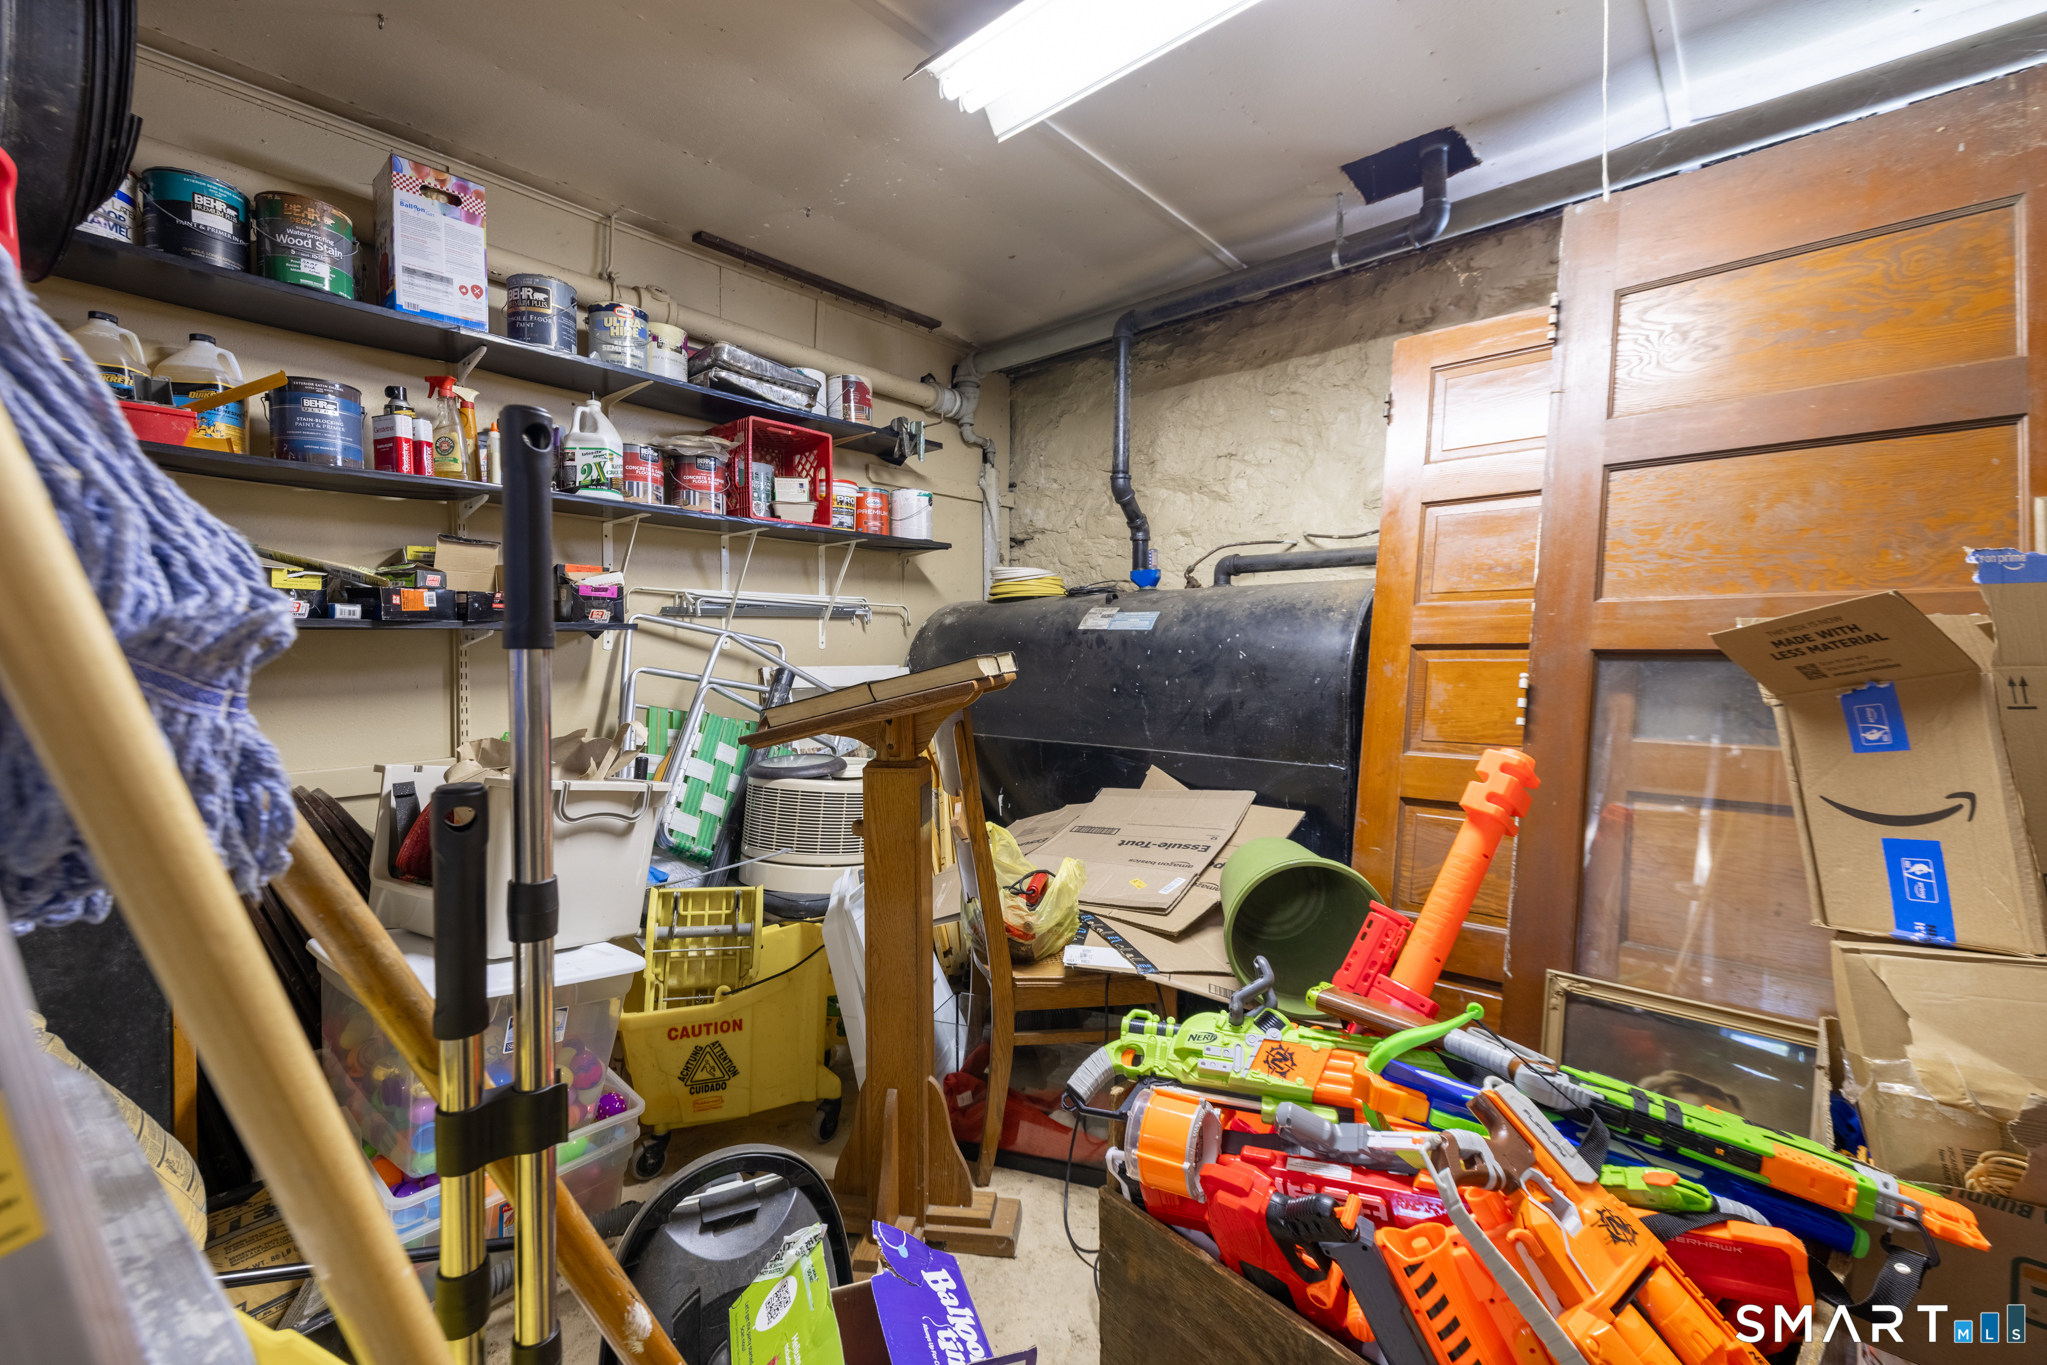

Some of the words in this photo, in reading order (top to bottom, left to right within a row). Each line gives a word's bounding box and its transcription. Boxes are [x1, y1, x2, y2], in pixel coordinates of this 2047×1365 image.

[194, 194, 226, 213] BEHR
[194, 204, 224, 218] PREMIUM
[207, 226, 232, 239] PRIMER
[286, 228, 334, 246] Waterproofing
[276, 234, 312, 248] Wood
[316, 242, 343, 259] Stain
[509, 288, 533, 301] BEHR
[610, 326, 639, 338] HIDE
[303, 399, 327, 408] BEHR
[296, 417, 343, 426] STAIN-BLOCKING
[322, 424, 346, 432] PRIMER
[581, 460, 608, 486] 2X
[837, 496, 855, 504] PRO
[1998, 552, 2027, 564] prime
[1787, 624, 1808, 632] BOX
[1819, 616, 1843, 625] NOW
[1770, 634, 1816, 648] MADE
[1814, 624, 1862, 639] WITH
[1770, 648, 1806, 660] LESS
[1806, 633, 1890, 653] MATERIAL
[1117, 840, 1211, 853] Essuie-Tout
[1128, 858, 1157, 866] basics
[1157, 861, 1194, 869] amazon
[667, 1019, 743, 1041] CAUTION
[1187, 1031, 1218, 1044] NERF
[677, 1045, 703, 1083] ACHTUNG
[710, 1040, 740, 1078] ATTENTION
[690, 1082, 727, 1095] CUIDADO
[281, 1248, 291, 1257] LB
[922, 1323, 931, 1343] Always
[928, 1343, 934, 1351] Up
